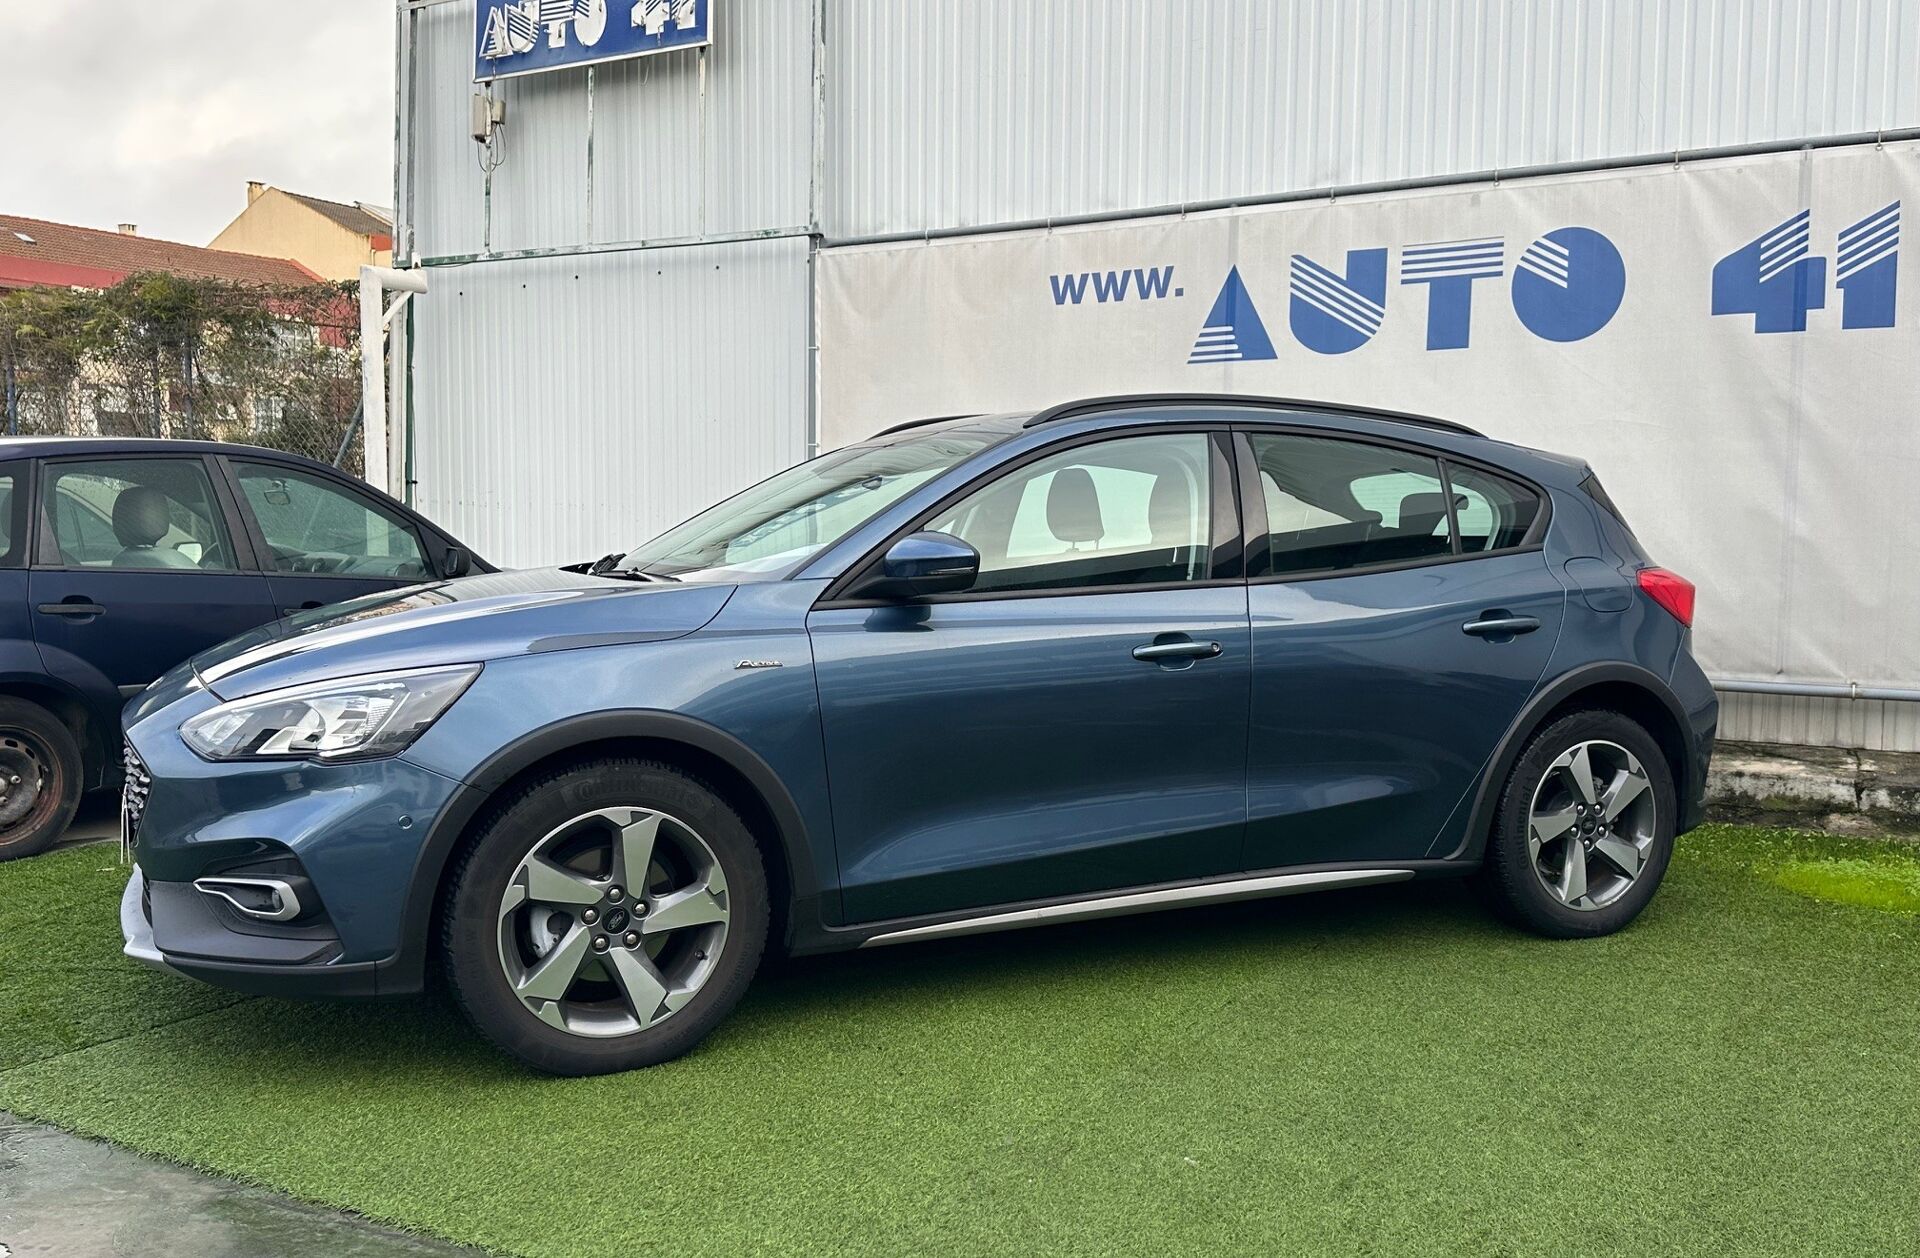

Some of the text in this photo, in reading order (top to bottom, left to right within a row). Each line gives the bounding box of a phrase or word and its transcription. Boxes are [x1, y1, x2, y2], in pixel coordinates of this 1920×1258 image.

[479, 0, 607, 58] AUTO
[1187, 227, 1626, 364] AUTO
[1711, 200, 1901, 333] 41
